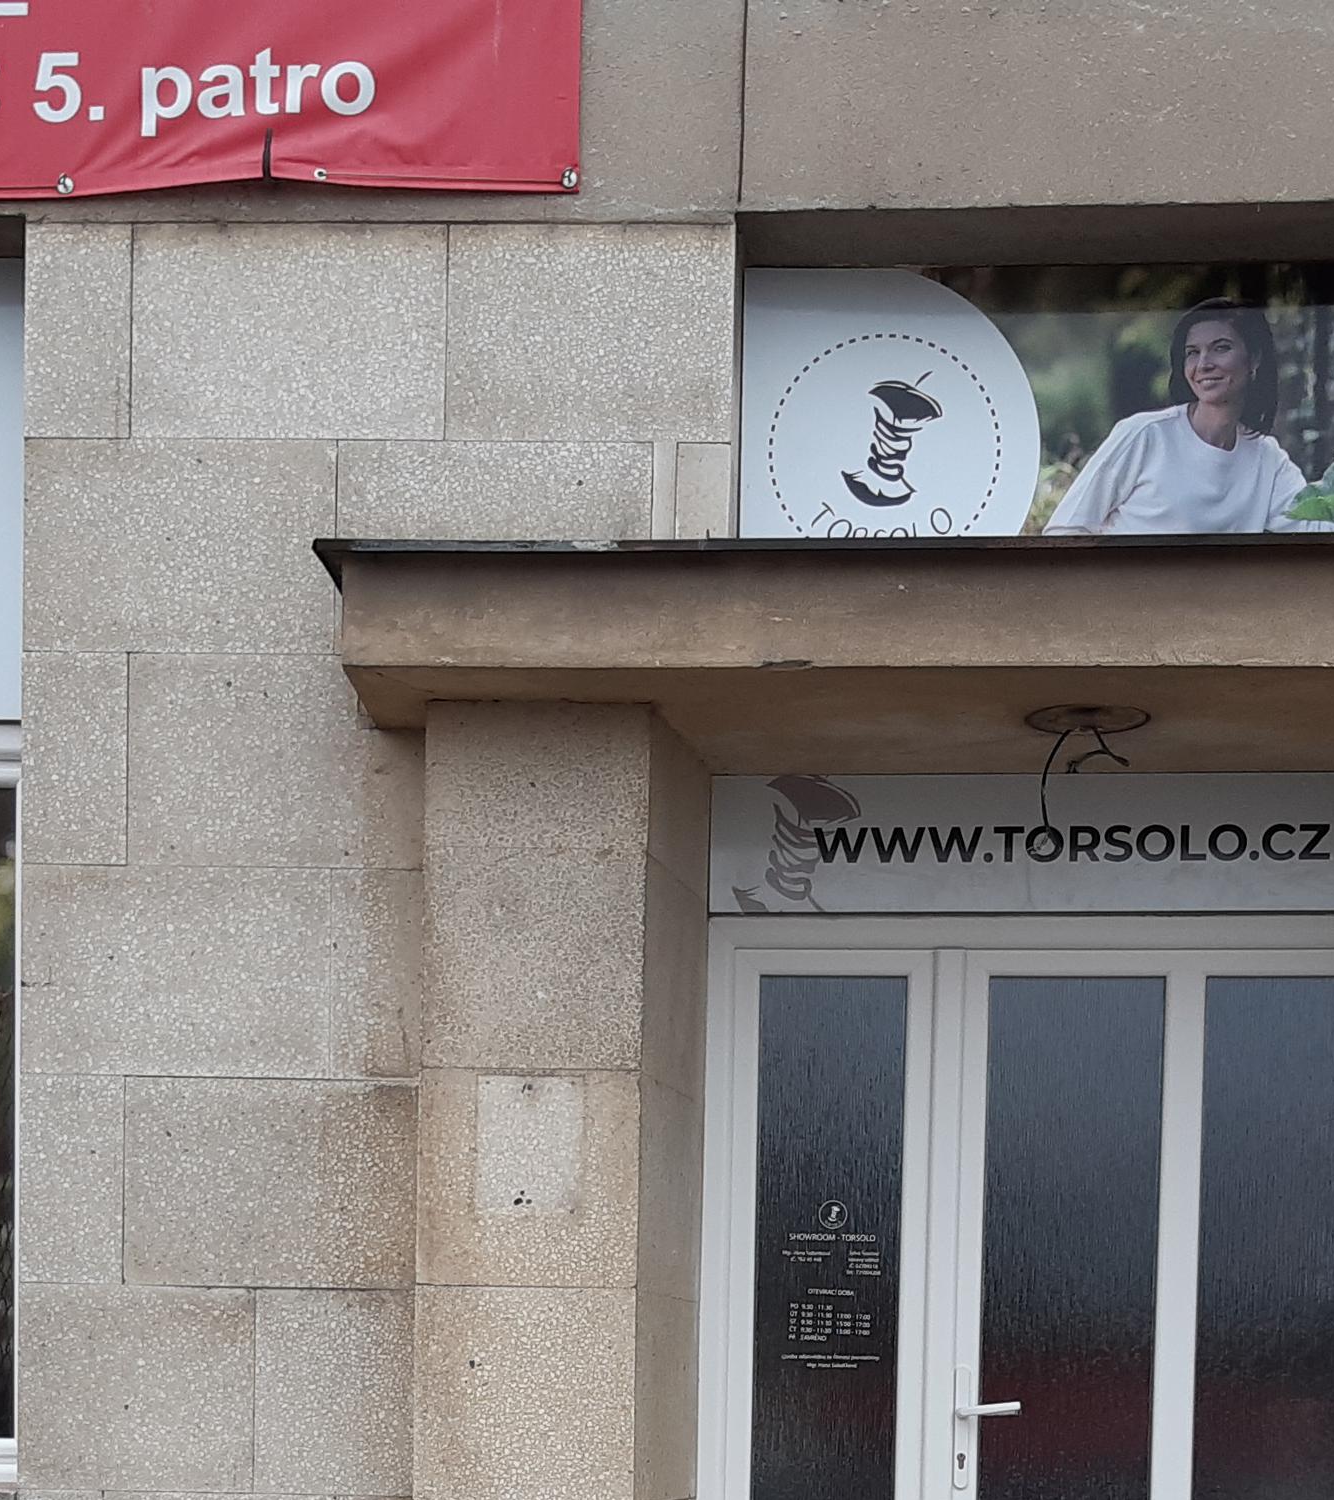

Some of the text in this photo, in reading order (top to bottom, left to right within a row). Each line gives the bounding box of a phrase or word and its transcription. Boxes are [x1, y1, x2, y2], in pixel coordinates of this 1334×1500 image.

[33, 51, 106, 124] 5.
[139, 48, 376, 137] patro
[812, 823, 1331, 864] WWW.TORSOLO.CZ
[789, 1233, 836, 1241] SHOWROOM
[841, 1233, 876, 1242] TORSOLO
